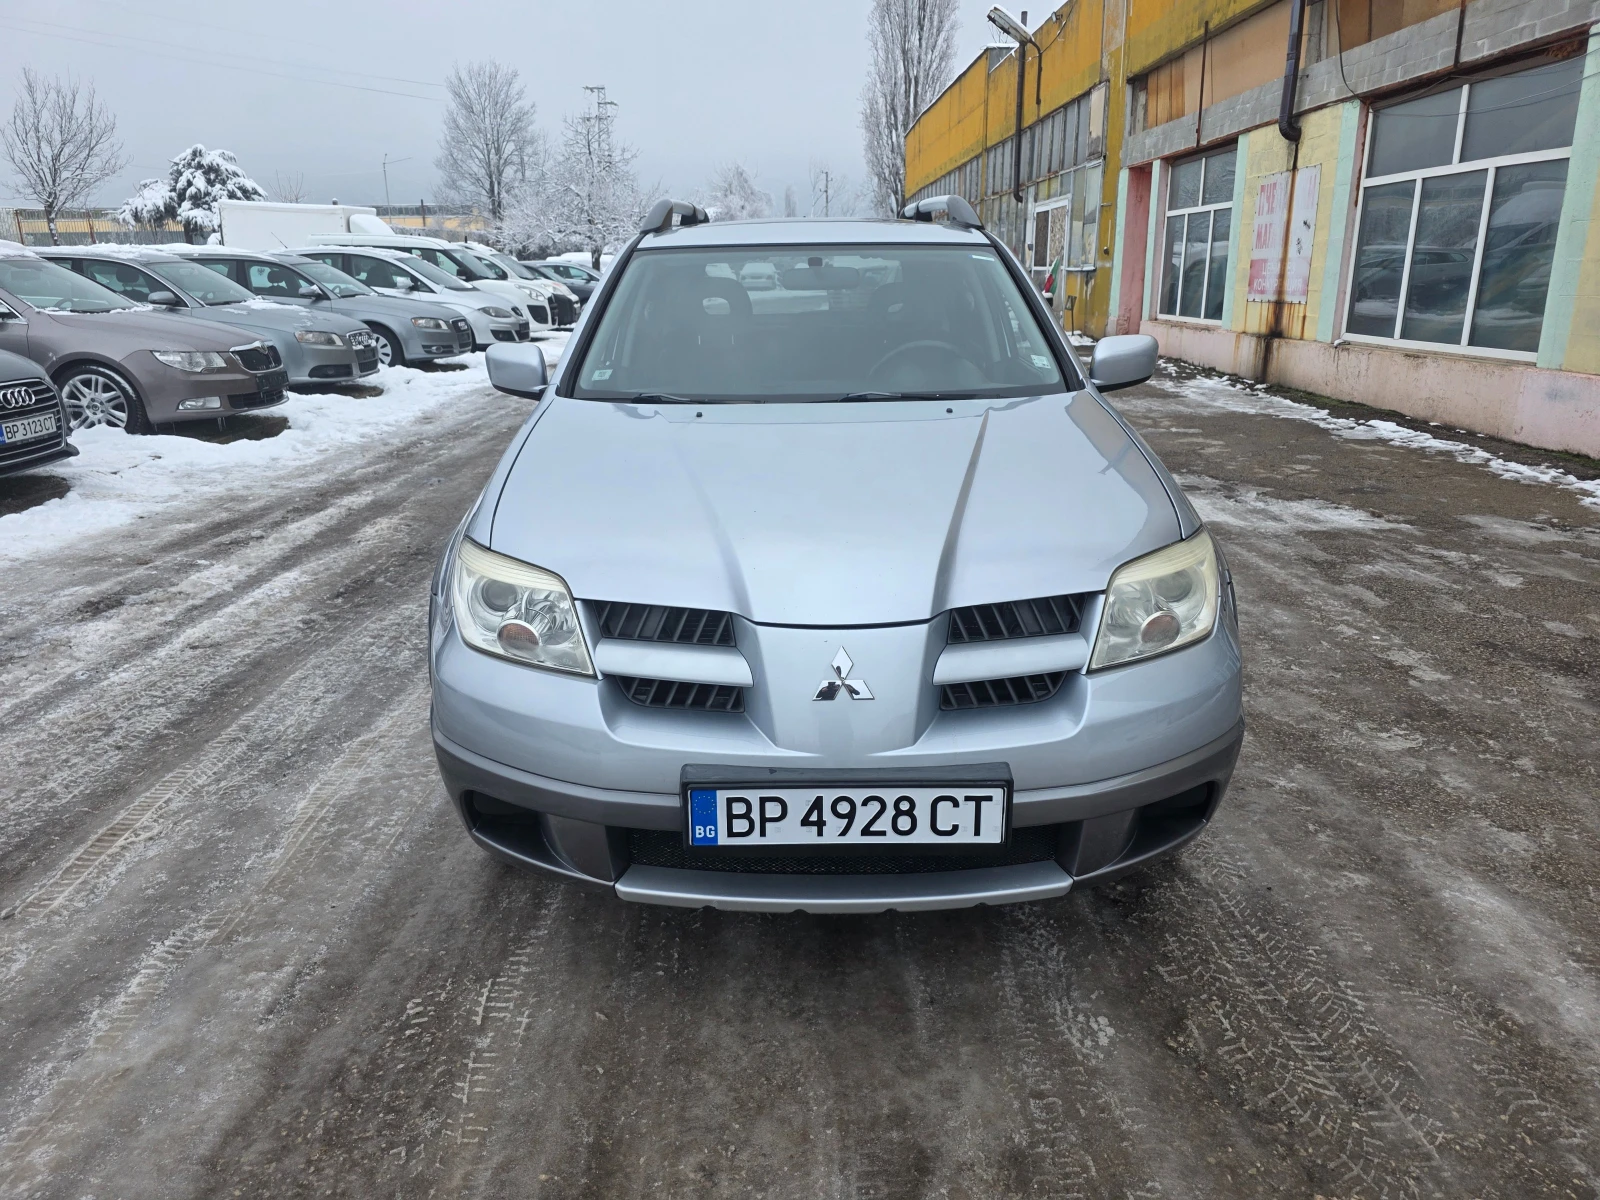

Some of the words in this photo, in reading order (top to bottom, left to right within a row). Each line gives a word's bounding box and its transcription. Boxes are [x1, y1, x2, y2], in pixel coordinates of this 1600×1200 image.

[5, 425, 19, 440] BP
[20, 420, 43, 436] 3123
[44, 416, 54, 431] CT
[725, 796, 788, 838] BP
[800, 795, 918, 837] 4928
[929, 795, 994, 837] CT
[695, 825, 716, 838] BG
